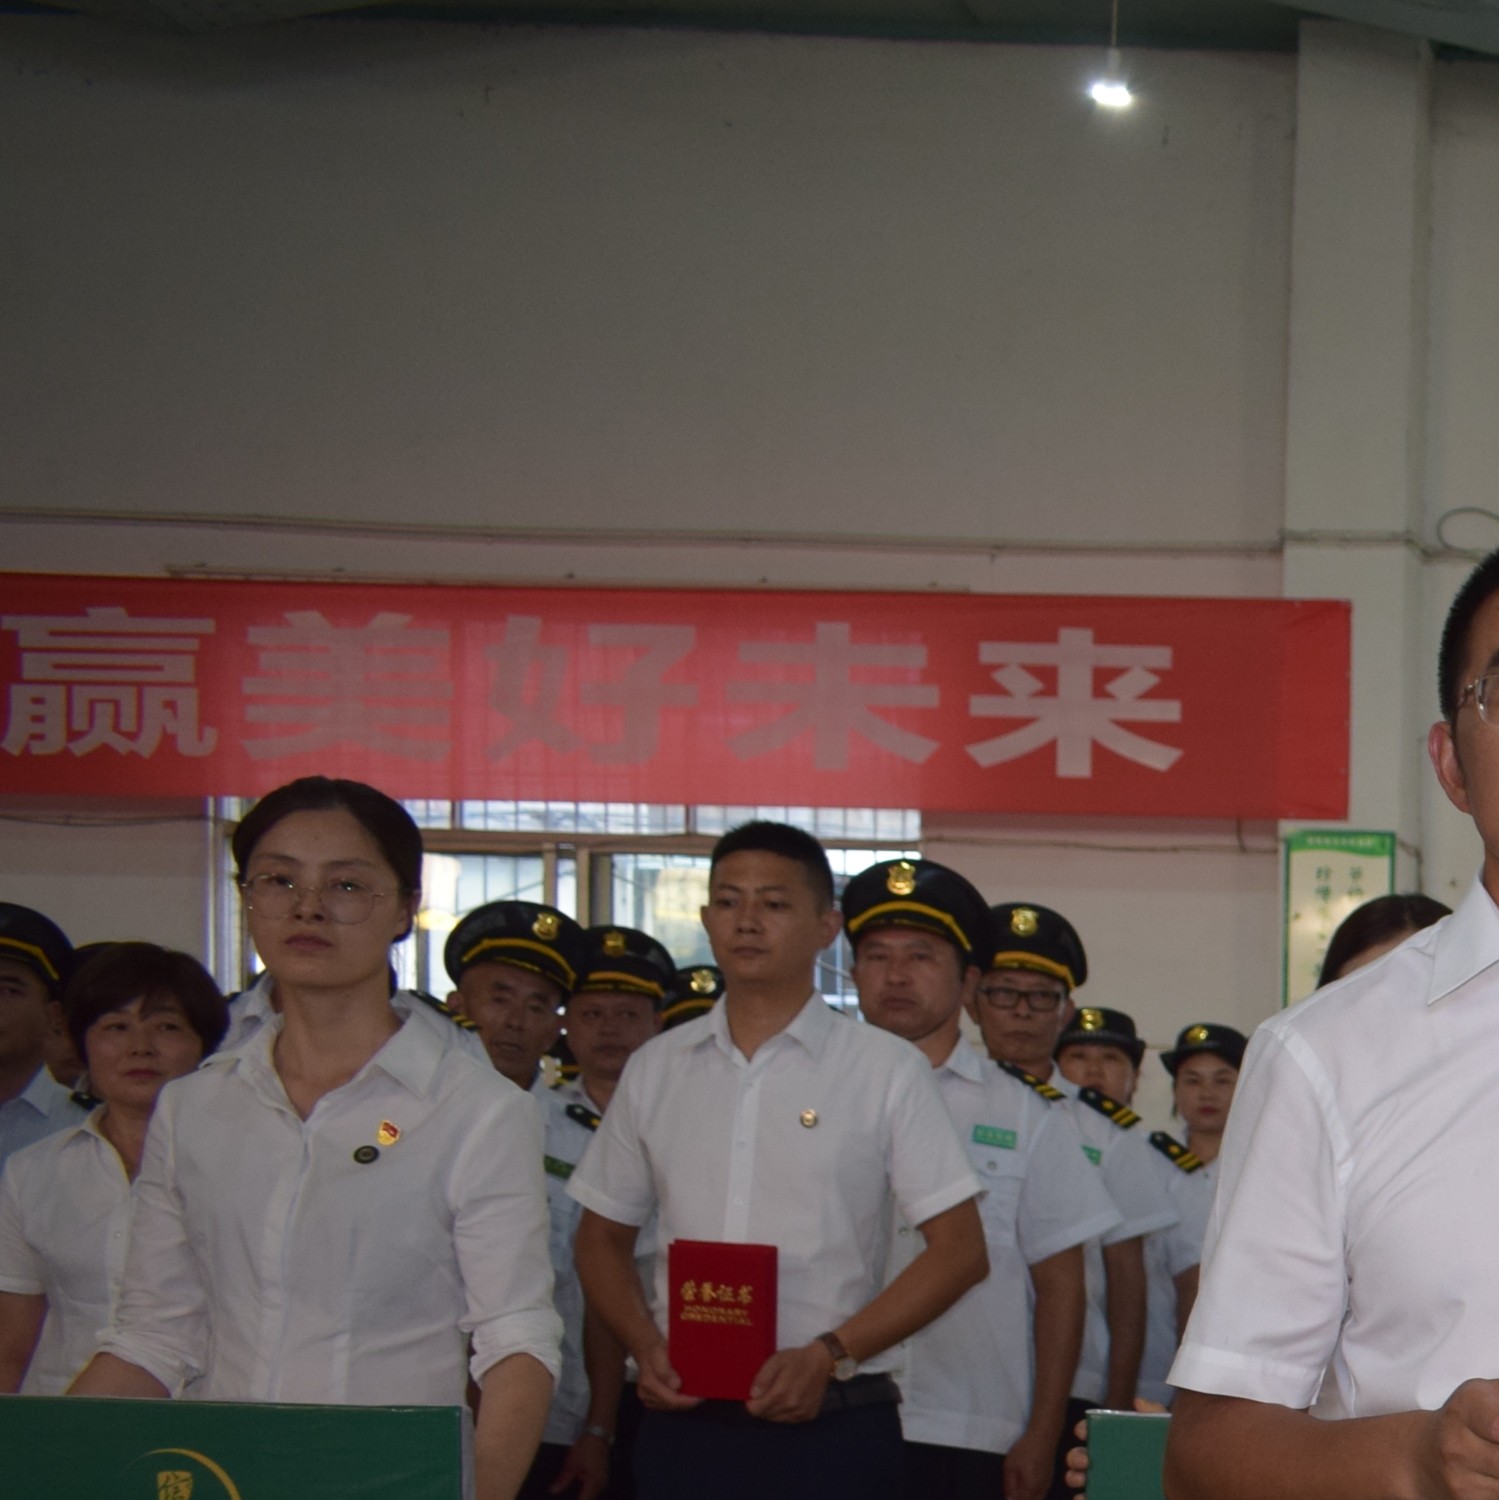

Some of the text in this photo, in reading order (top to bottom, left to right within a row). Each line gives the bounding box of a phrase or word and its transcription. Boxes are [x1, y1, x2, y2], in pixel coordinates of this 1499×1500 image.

[0, 605, 1185, 779] 赢美好未来
